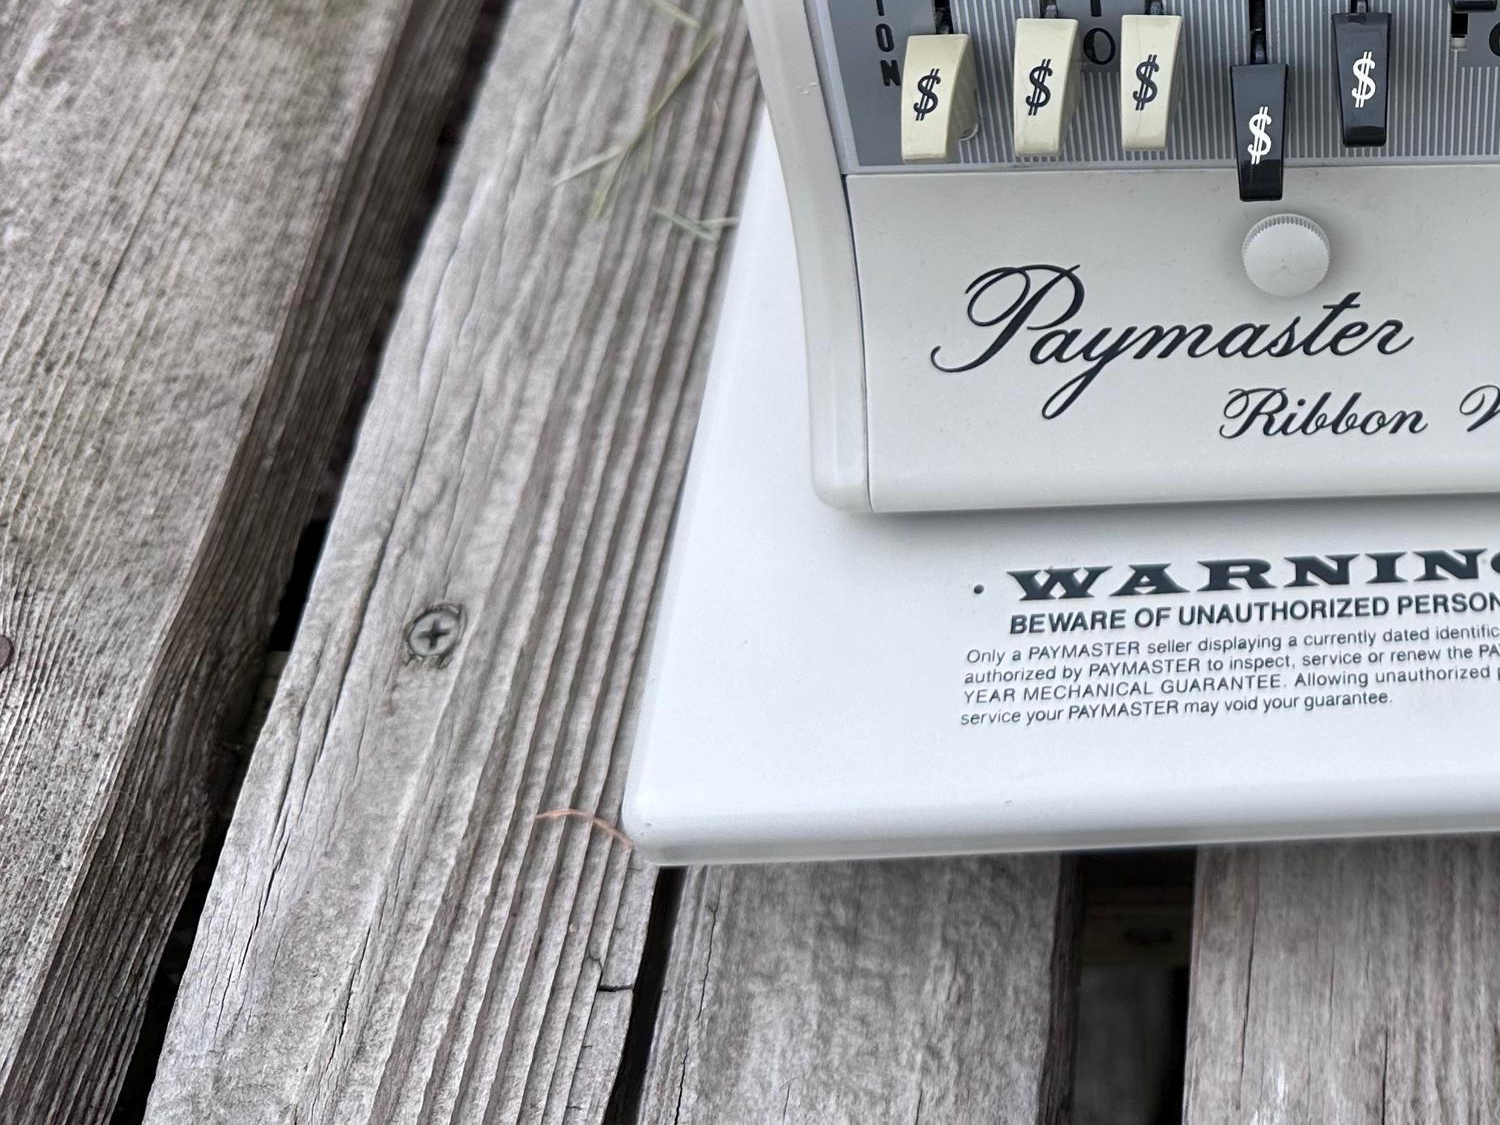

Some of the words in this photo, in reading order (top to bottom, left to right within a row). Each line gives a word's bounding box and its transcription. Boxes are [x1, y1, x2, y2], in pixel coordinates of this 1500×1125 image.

[1083, 27, 1116, 65] 0
[913, 68, 941, 121] $
[1025, 58, 1053, 116] $
[1132, 54, 1159, 111] $
[1351, 51, 1376, 108] $
[1247, 106, 1272, 165] $
[930, 264, 1414, 420] Paymaster
[1219, 387, 1428, 440] Ribbon
[1010, 609, 1126, 635] BEWARE
[1134, 606, 1172, 628] OF
[1178, 596, 1389, 626] UNAUTHORIZED
[965, 667, 1056, 684] authorized
[1063, 665, 1083, 682] by
[1089, 658, 1200, 677] PAYMASTER
[1207, 657, 1223, 671] to
[1230, 654, 1296, 674] inspect,
[1302, 649, 1362, 667] service
[1368, 651, 1385, 663] or
[1390, 648, 1441, 662] renew
[1447, 645, 1473, 659] the
[967, 649, 1005, 666] Only
[1012, 651, 1022, 662] a
[1029, 641, 1140, 660] PAYMASTER
[1147, 639, 1192, 655] seller
[1198, 634, 1282, 655] displaying
[1288, 635, 1298, 647] a
[1304, 630, 1376, 647] currently
[1383, 627, 1430, 643] dated
[961, 710, 1021, 726] service
[1026, 709, 1064, 726] your
[1068, 699, 1179, 720] PAYMASTER
[1184, 701, 1219, 717] may
[1224, 696, 1258, 712] void
[1263, 695, 1299, 712] your
[1304, 690, 1393, 711] guarantee.
[964, 688, 1016, 704] YEAR
[1023, 681, 1153, 702] MECHANICAL
[1160, 674, 1287, 695] GUARANTEE.
[1294, 670, 1369, 688] Allowing
[1375, 665, 1491, 683] unauthorized
